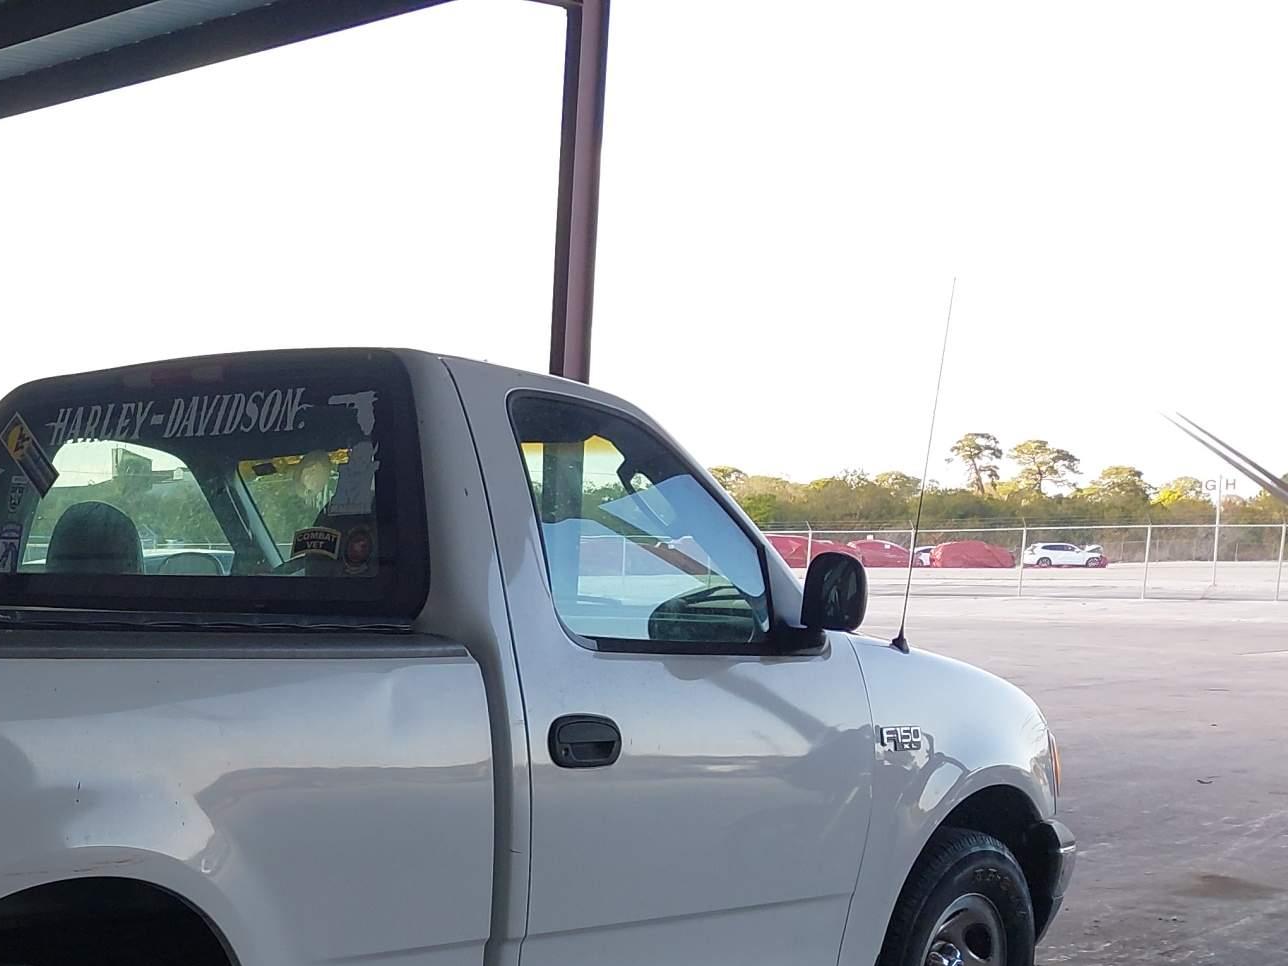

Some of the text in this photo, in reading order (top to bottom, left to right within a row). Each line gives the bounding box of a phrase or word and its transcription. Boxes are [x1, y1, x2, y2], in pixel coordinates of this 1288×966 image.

[1205, 479, 1217, 491] G
[1225, 478, 1236, 490] H
[295, 530, 337, 543] COMBAT
[305, 540, 324, 549] VET
[881, 726, 922, 746] F150
